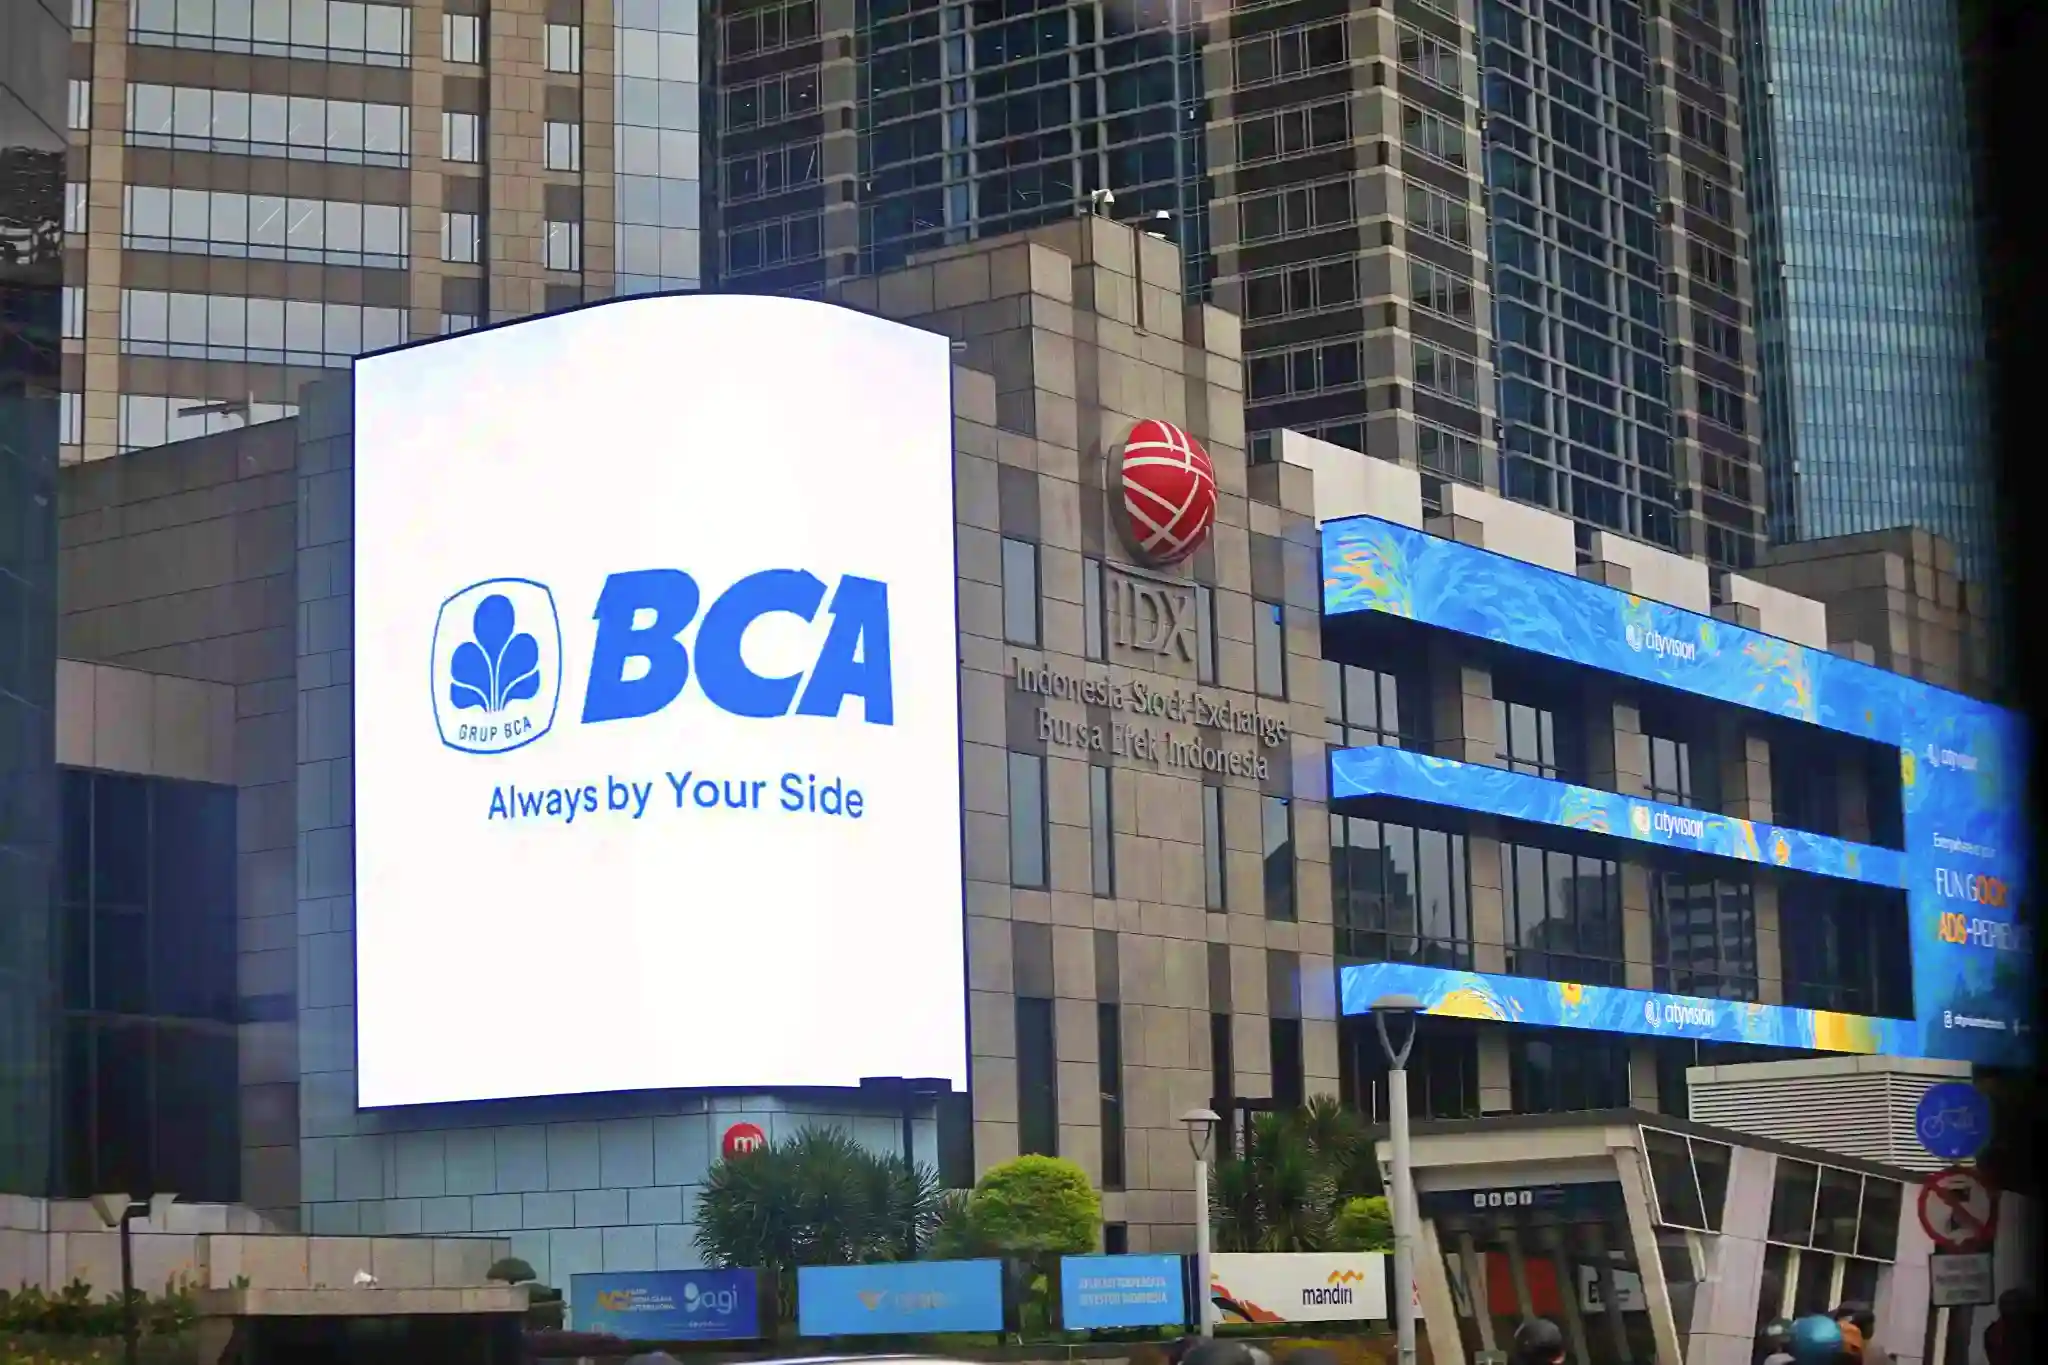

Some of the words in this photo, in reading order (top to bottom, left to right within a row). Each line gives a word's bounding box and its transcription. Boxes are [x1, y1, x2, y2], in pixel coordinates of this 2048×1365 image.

[1112, 579, 1192, 662] IDX
[581, 568, 894, 726] BCA
[1645, 628, 1696, 661] cityvision
[1012, 656, 1124, 709] Indonesia
[1131, 679, 1187, 723] Stock
[1193, 691, 1289, 748] Exchange
[459, 723, 498, 742] GRUP
[503, 716, 532, 740] BCA
[1035, 707, 1104, 750] Bursa
[1111, 721, 1158, 762] Efek
[1166, 731, 1269, 781] Indonesia
[488, 784, 598, 824] Always
[607, 775, 653, 819] by
[666, 771, 766, 809] Your
[780, 772, 864, 819] Side
[1653, 809, 1705, 839] cityvision
[1664, 1002, 1715, 1030] cityvision
[1302, 1281, 1353, 1306] mandiri
